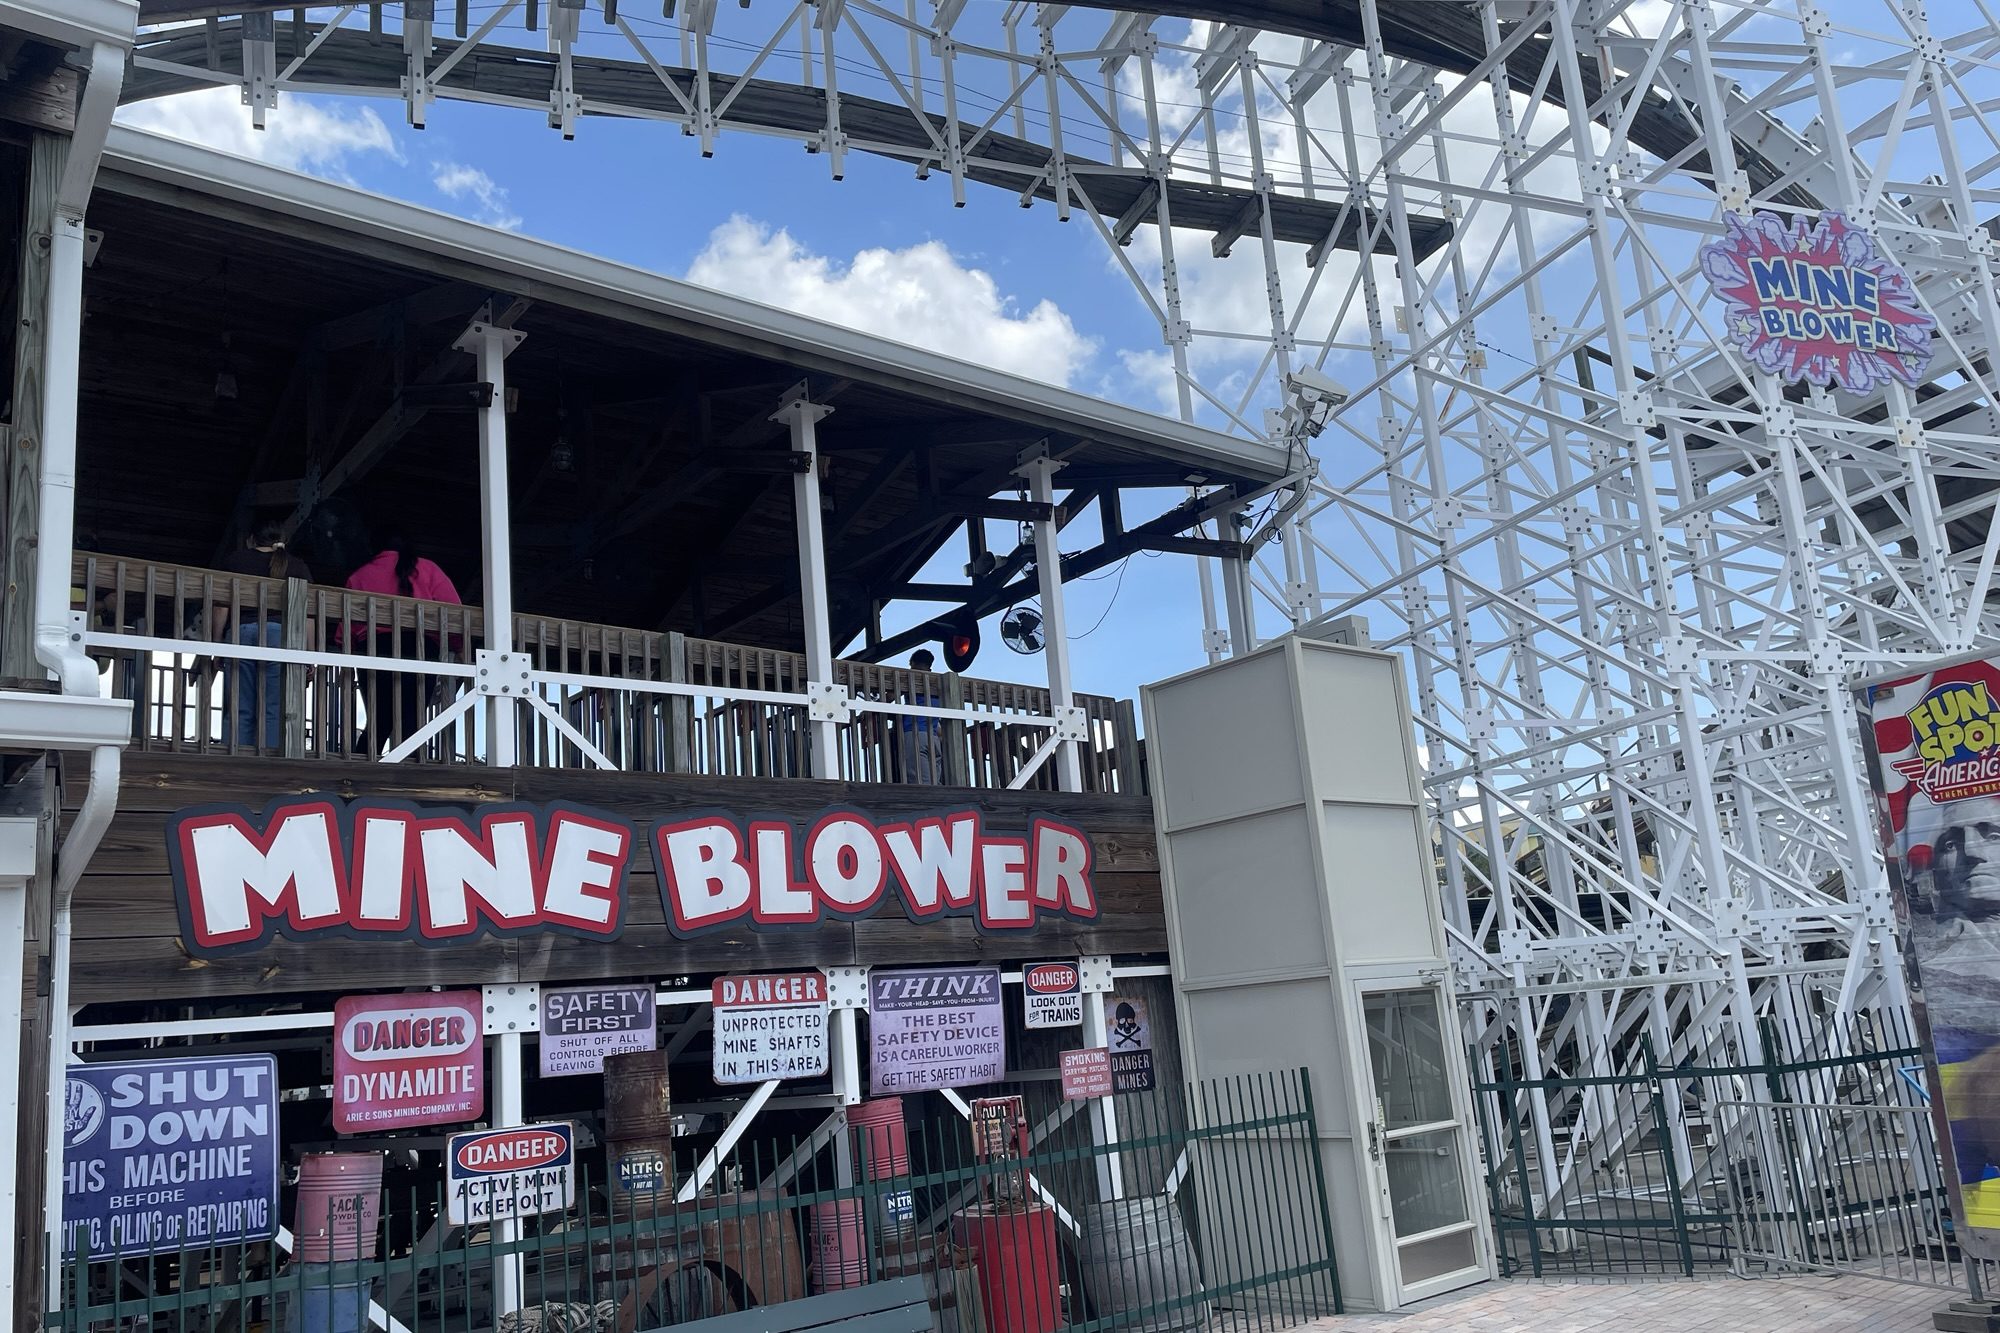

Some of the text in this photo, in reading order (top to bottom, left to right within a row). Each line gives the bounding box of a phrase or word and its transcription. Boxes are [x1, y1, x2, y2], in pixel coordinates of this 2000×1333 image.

[1749, 258, 1878, 313] MINE
[1761, 308, 1897, 351] BLOWER
[1908, 684, 1990, 739] FUN
[1921, 757, 2000, 791] AMERIC
[1939, 787, 1968, 800] THEME
[186, 807, 1095, 941] MINE BLOWER
[878, 973, 995, 1000] THINK
[1031, 970, 1073, 987] DANGER
[722, 976, 819, 1004] DANGER
[548, 991, 648, 1020] SAFETY
[1031, 996, 1077, 1008] LOOK OUT
[561, 1014, 636, 1033] FIRST
[722, 1014, 821, 1033] UNPROTECTED
[902, 1012, 975, 1028] THE BEST
[1029, 1007, 1080, 1023] FOR TRAINS
[353, 1015, 466, 1053] DANGER
[560, 1033, 639, 1048] SHUT OFF ALL
[723, 1035, 821, 1055] MINE SHAFTS
[877, 1025, 999, 1047] SAFETY DEVICE
[549, 1047, 604, 1061] CONTROLS
[877, 1042, 1000, 1064] IS A CAREFUL WORKER
[1065, 1051, 1106, 1067] SMOKING
[1112, 1054, 1150, 1072] DANGER
[550, 1060, 596, 1072] LEAVING
[722, 1056, 823, 1077] IN THIS AREA
[881, 1063, 997, 1087] GET THE SAFETY HABIT
[110, 1065, 268, 1108] SHUT
[343, 1064, 476, 1104] DYNAMITE
[1072, 1076, 1086, 1085] OPEN
[1117, 1071, 1148, 1090] MINES
[346, 1112, 364, 1123] ARIE
[365, 1111, 371, 1121] &
[372, 1108, 393, 1120] SONS
[393, 1106, 420, 1119] MINING
[458, 1101, 473, 1112] INC.
[109, 1104, 268, 1150] DOWN
[467, 1135, 559, 1167] DANGER
[62, 1144, 252, 1195] HIS MACHINE
[621, 1160, 664, 1176] NITRO
[456, 1175, 520, 1199] ACTIVE
[109, 1188, 185, 1210] BEFORE
[473, 1191, 554, 1217] KEEP OUT
[887, 1196, 913, 1210] NITR
[186, 1197, 268, 1237] REPAIRNG
[326, 1212, 357, 1221] OWDE
